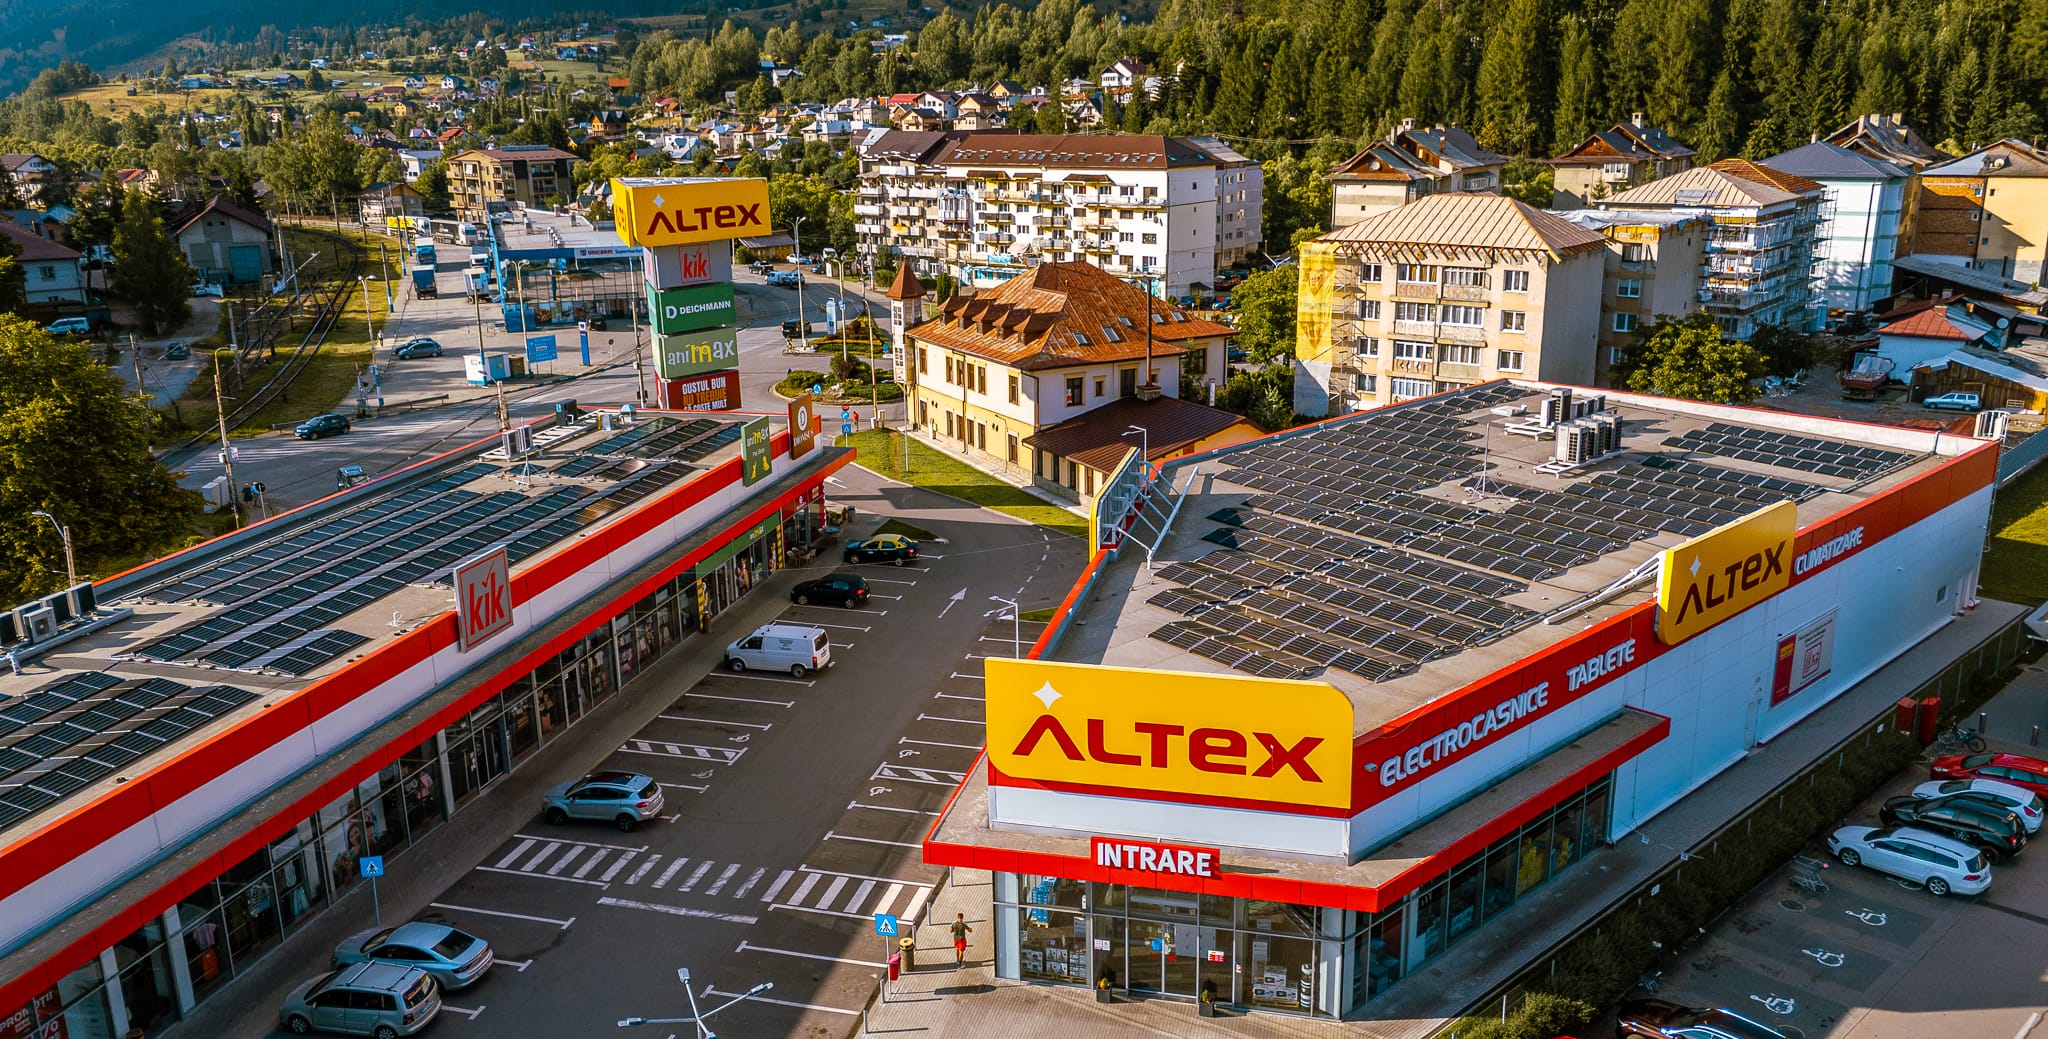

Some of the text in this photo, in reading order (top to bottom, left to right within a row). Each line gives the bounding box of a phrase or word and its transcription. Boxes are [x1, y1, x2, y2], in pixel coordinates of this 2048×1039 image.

[683, 249, 708, 279] kik
[680, 300, 731, 315] DEICHMANN
[668, 340, 735, 366] animax
[682, 376, 726, 395] GUSTUL BUN
[683, 388, 727, 406] NU TREBUIE
[712, 399, 727, 408] MULT
[1794, 525, 1864, 576] CLIMATIZARE
[469, 561, 505, 636] kik
[1379, 638, 1635, 787] ELECTROCASNICE TABLETE
[1097, 842, 1212, 877] INTRARE
